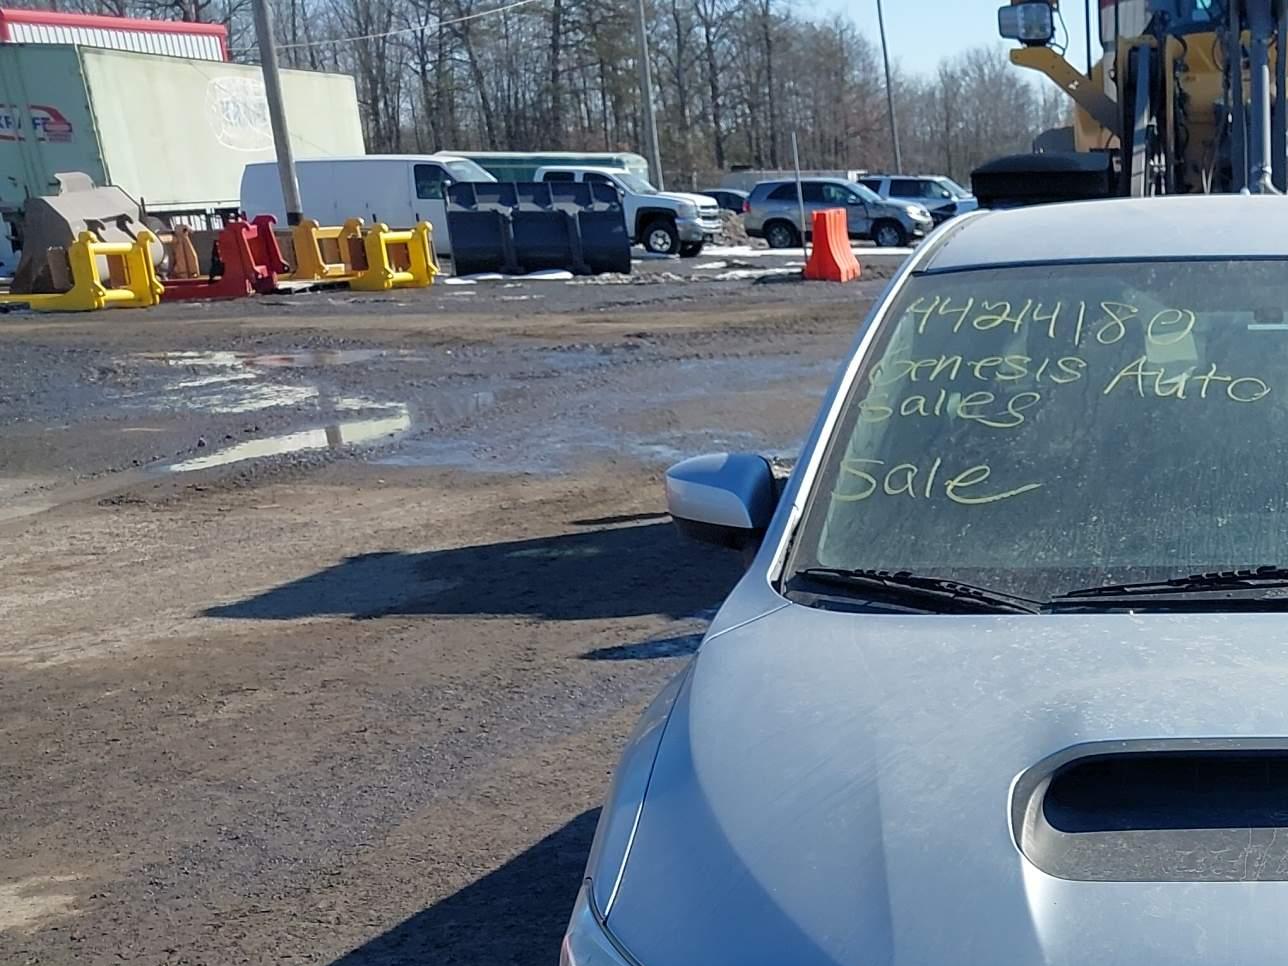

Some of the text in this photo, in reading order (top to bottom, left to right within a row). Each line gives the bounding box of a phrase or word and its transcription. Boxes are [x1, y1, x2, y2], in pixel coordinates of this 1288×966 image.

[868, 347, 1272, 403] Genesis Auto
[831, 456, 1043, 504] Sale
